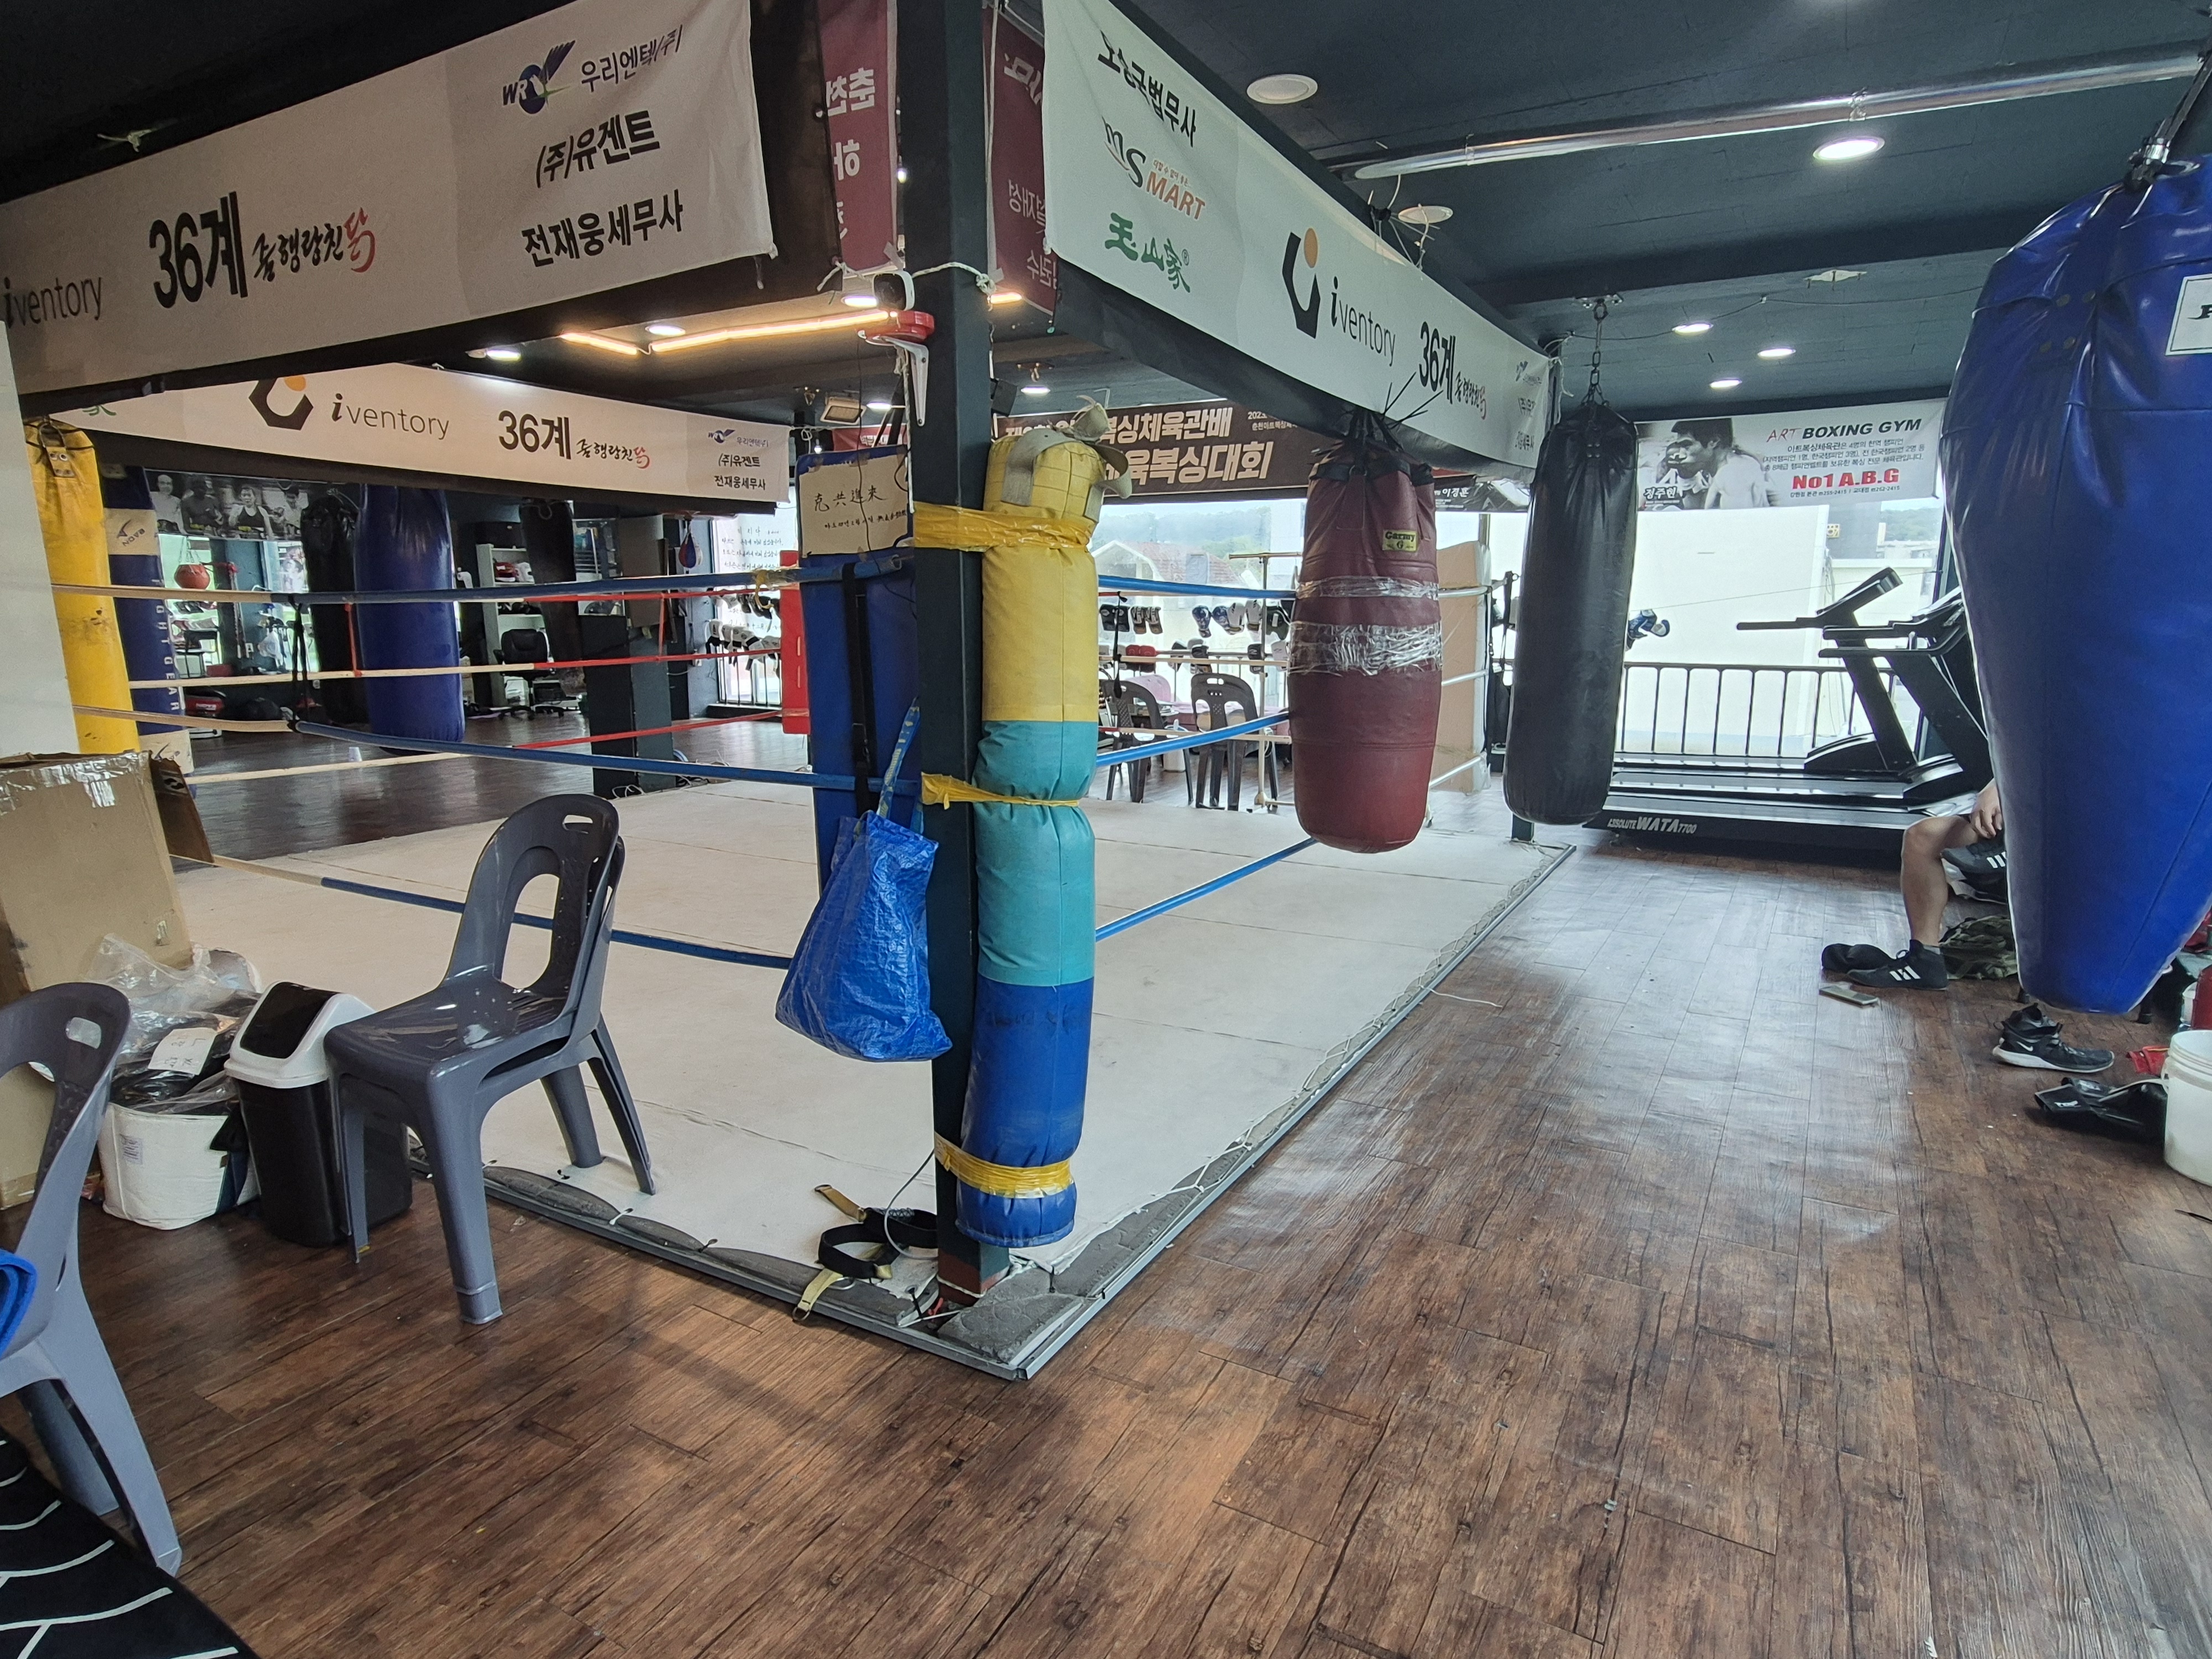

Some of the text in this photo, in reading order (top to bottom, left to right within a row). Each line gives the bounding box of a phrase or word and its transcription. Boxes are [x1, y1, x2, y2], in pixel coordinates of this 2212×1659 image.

[535, 110, 660, 188] (주)유겐트
[1146, 171, 1206, 220] MART
[149, 191, 248, 309] 36계
[521, 189, 684, 268] 전재웅세무사
[2, 276, 103, 328] iventory
[1330, 276, 1396, 367] iventory
[1418, 321, 1456, 404] 36계
[331, 393, 450, 441] iventory
[498, 410, 571, 460] 36계
[1766, 419, 1922, 442] ART BOXING GYM
[713, 475, 766, 491] 전재웅세무사
[718, 453, 760, 467] (주)유겐트
[1792, 468, 1900, 489] No1 A.B.G
[1636, 816, 1679, 833] WATA
